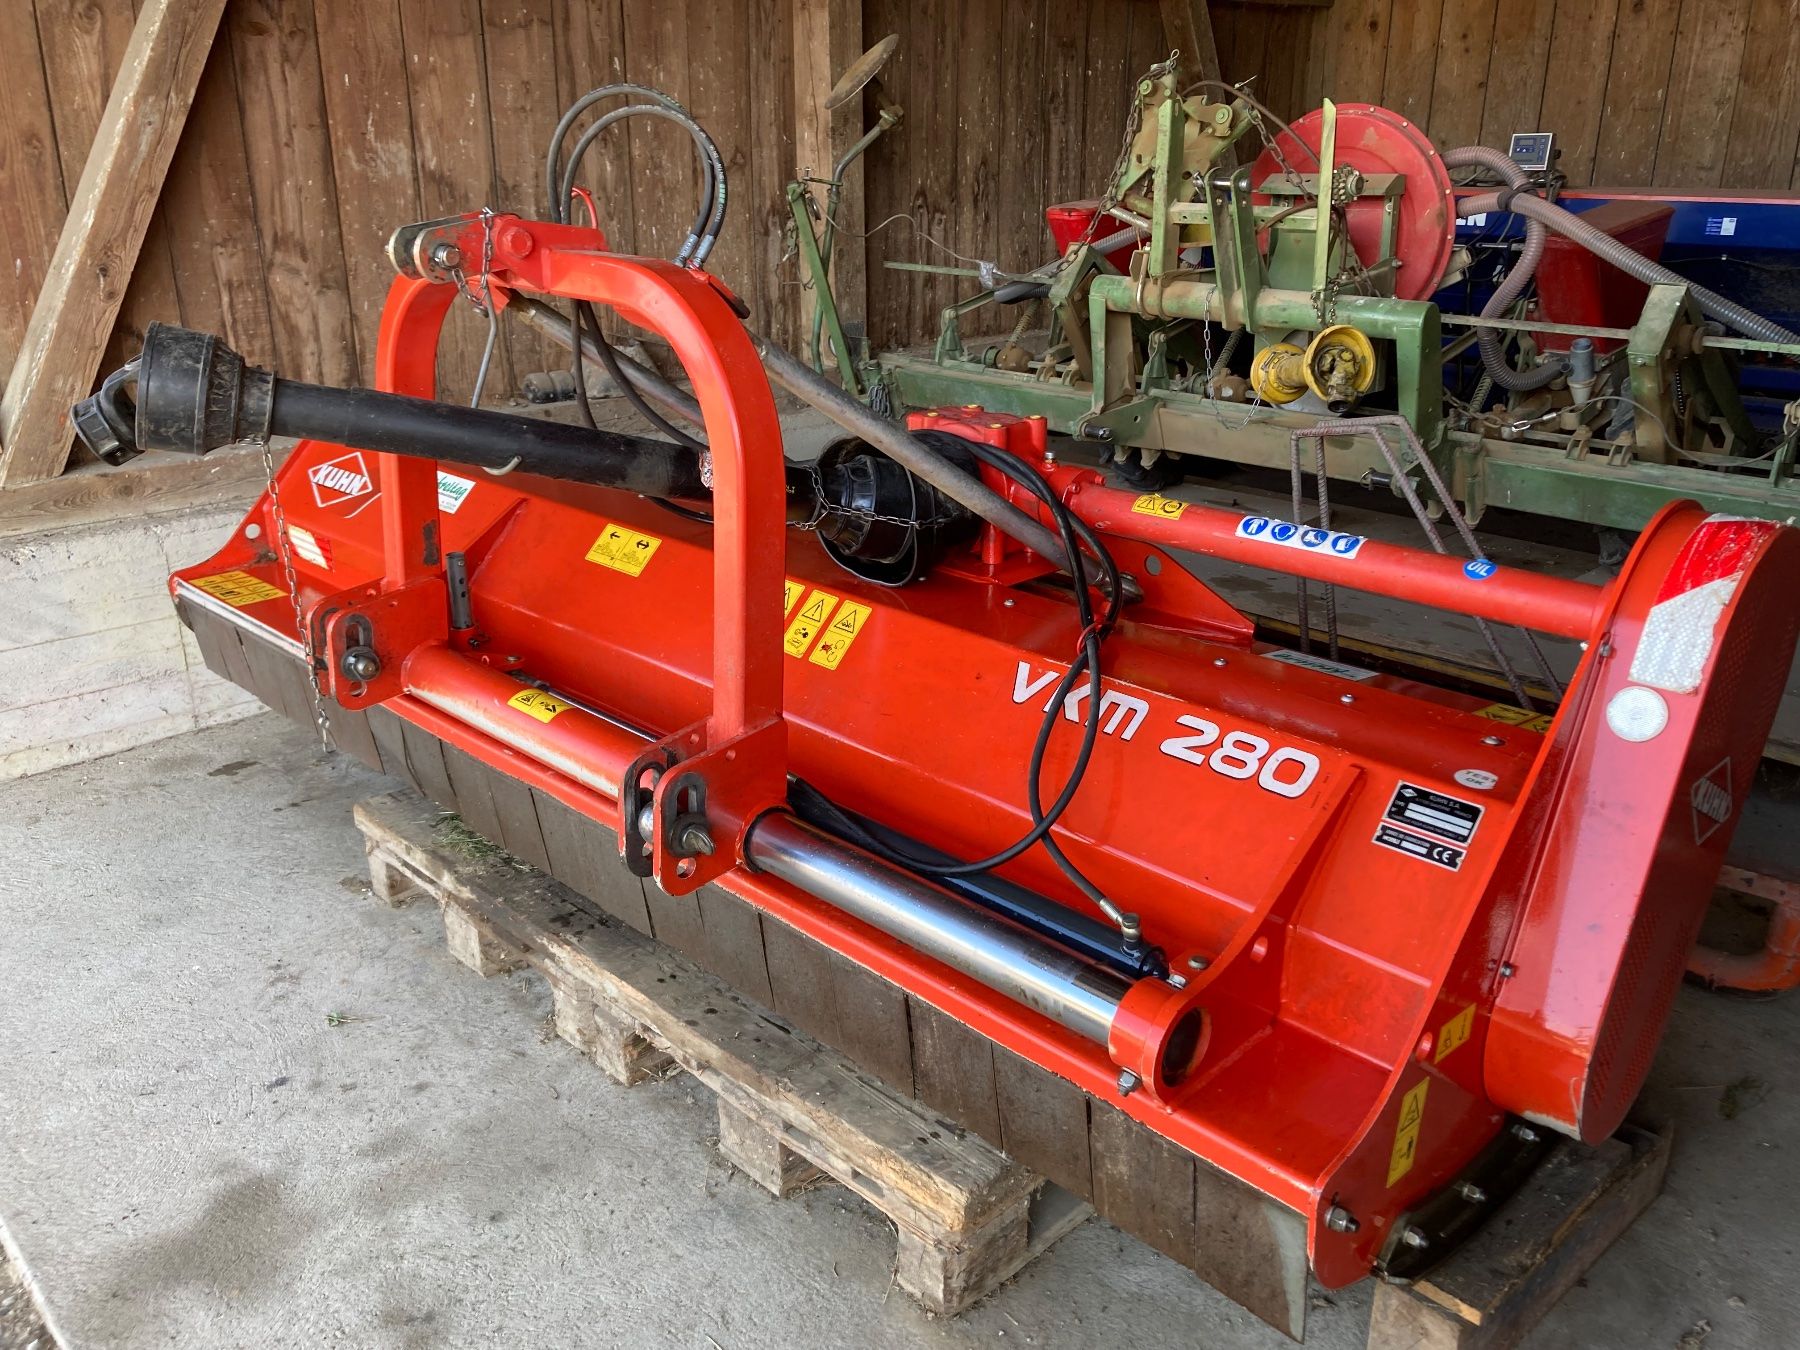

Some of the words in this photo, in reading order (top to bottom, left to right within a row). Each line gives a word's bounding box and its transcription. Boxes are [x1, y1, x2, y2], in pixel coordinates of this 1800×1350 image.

[313, 464, 368, 495] KUHN
[1466, 561, 1492, 577] OIL
[1012, 660, 1150, 742] VKM
[1158, 713, 1321, 799] 280
[1693, 777, 1732, 824] KUHN
[1432, 847, 1453, 863] CE
